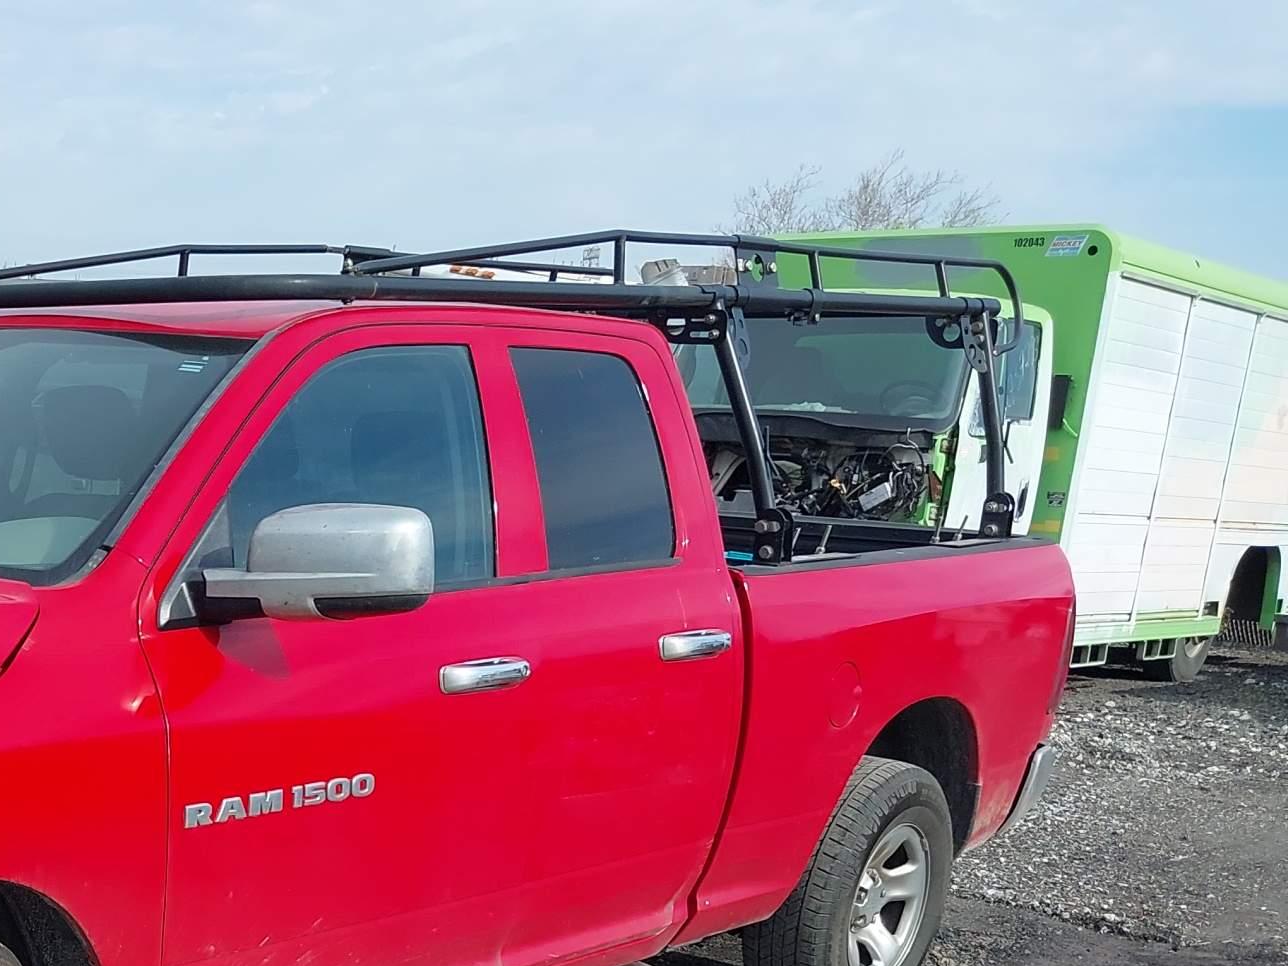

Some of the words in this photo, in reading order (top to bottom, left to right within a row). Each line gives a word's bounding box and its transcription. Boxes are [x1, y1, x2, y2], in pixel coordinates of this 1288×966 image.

[1014, 237, 1045, 248] 102043
[184, 788, 283, 828] RAM
[292, 773, 376, 808] 1500
